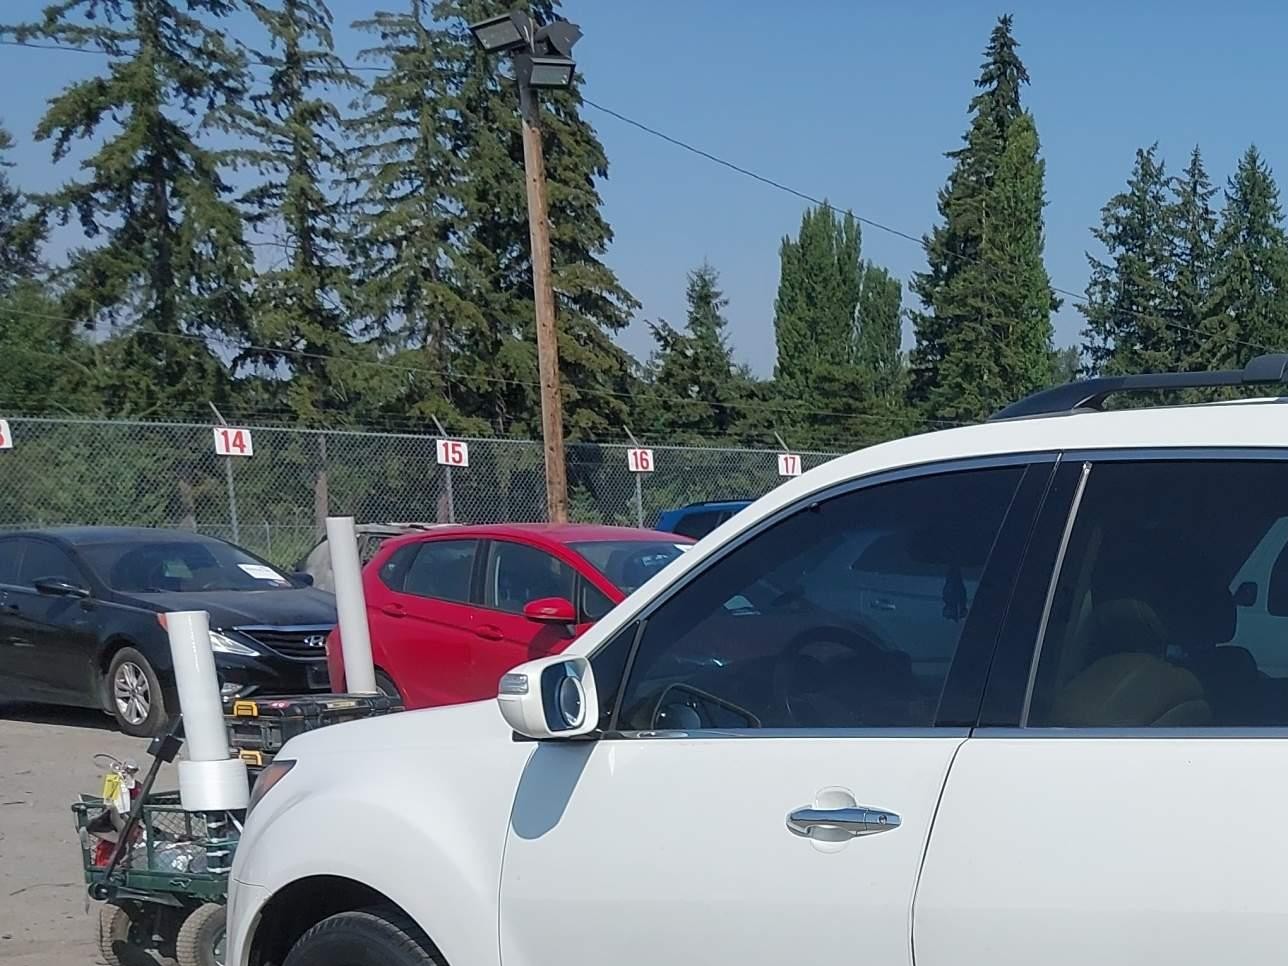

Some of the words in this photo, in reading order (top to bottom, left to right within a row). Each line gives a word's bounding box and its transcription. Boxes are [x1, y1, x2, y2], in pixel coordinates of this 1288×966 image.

[221, 430, 246, 453] 14
[442, 443, 463, 465] 15
[633, 450, 649, 470] 16
[783, 457, 796, 473] 17
